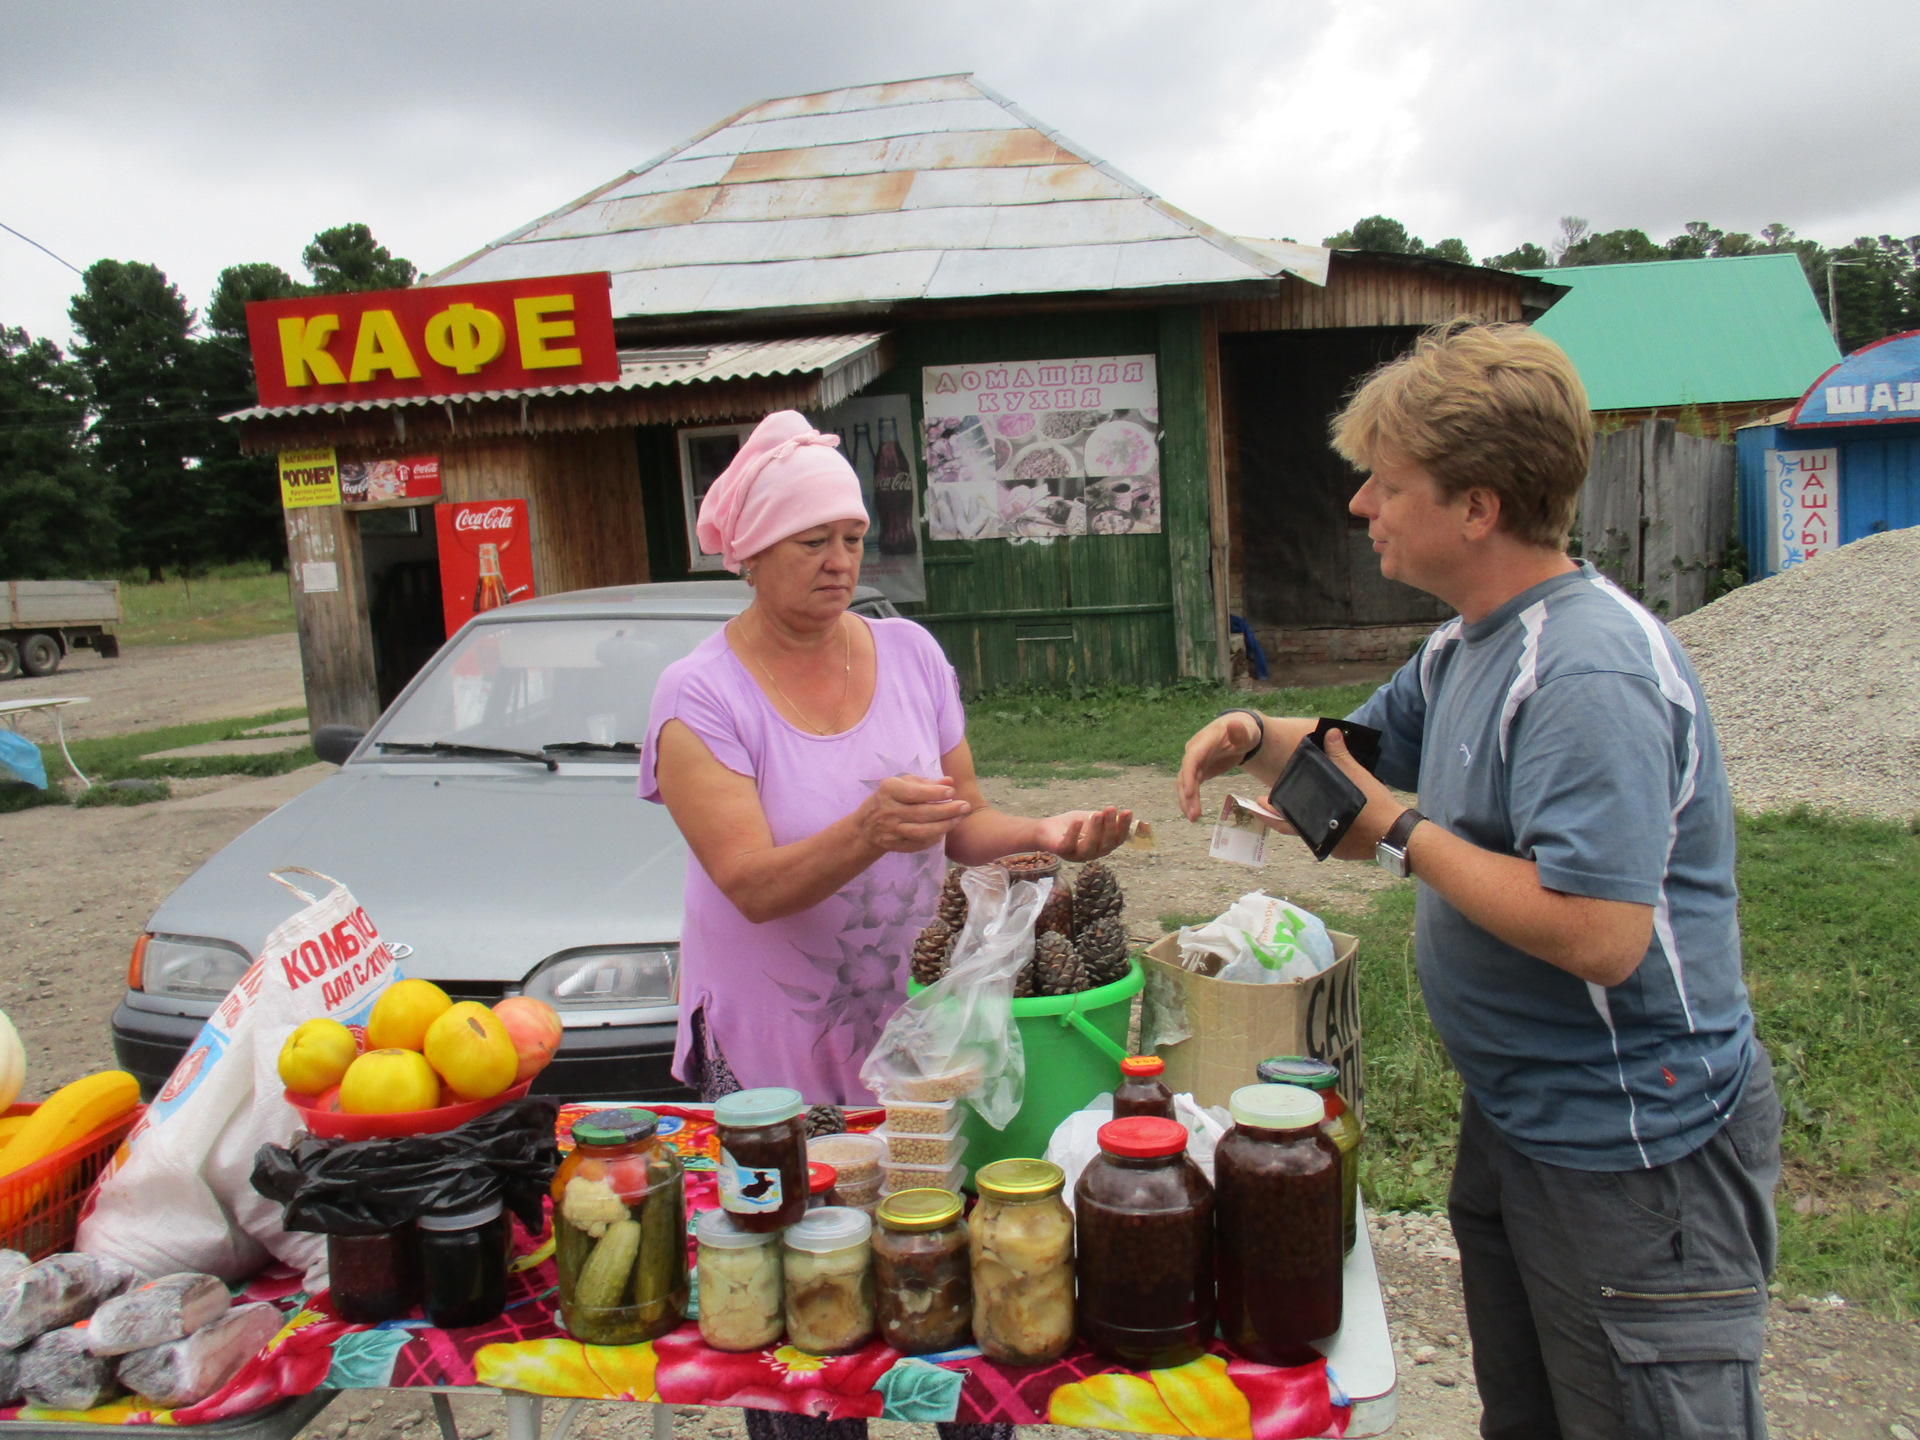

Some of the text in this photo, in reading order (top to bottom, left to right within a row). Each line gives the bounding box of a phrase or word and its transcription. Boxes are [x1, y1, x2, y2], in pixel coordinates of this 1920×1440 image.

[277, 294, 583, 388] КАФЕ
[935, 362, 1143, 394] ДОМАШНЯЯ
[978, 388, 1101, 412] КУХНЯ
[455, 507, 514, 531] Coca-Cola
[1800, 455, 1828, 560] ШАШЛЫК
[321, 970, 355, 1011] ДЛЯ
